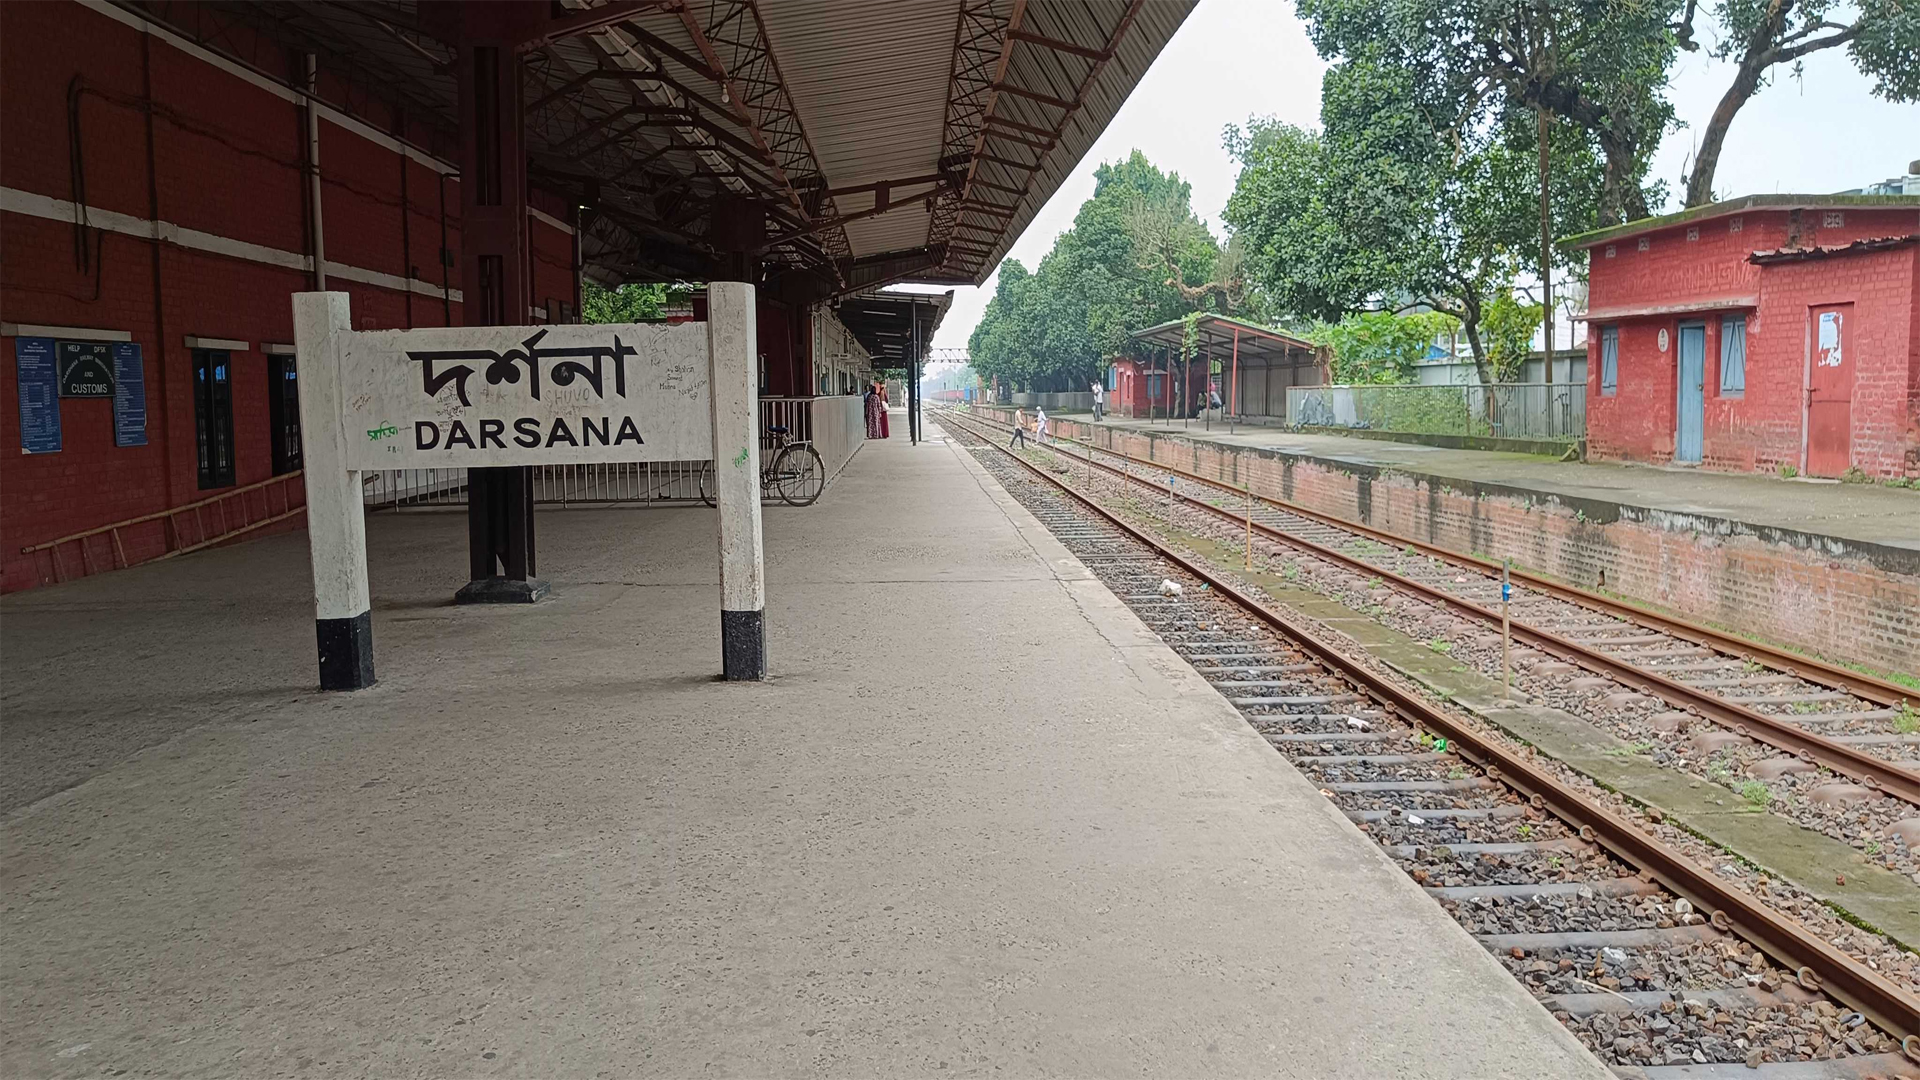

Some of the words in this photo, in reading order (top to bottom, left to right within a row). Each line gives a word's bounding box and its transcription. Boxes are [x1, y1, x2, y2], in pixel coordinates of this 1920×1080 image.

[67, 344, 81, 352] HELP
[405, 328, 639, 407] দর্শনা
[71, 383, 108, 394] CUSTOMS
[543, 387, 590, 407] SHUVO
[415, 416, 645, 450] DARSANA
